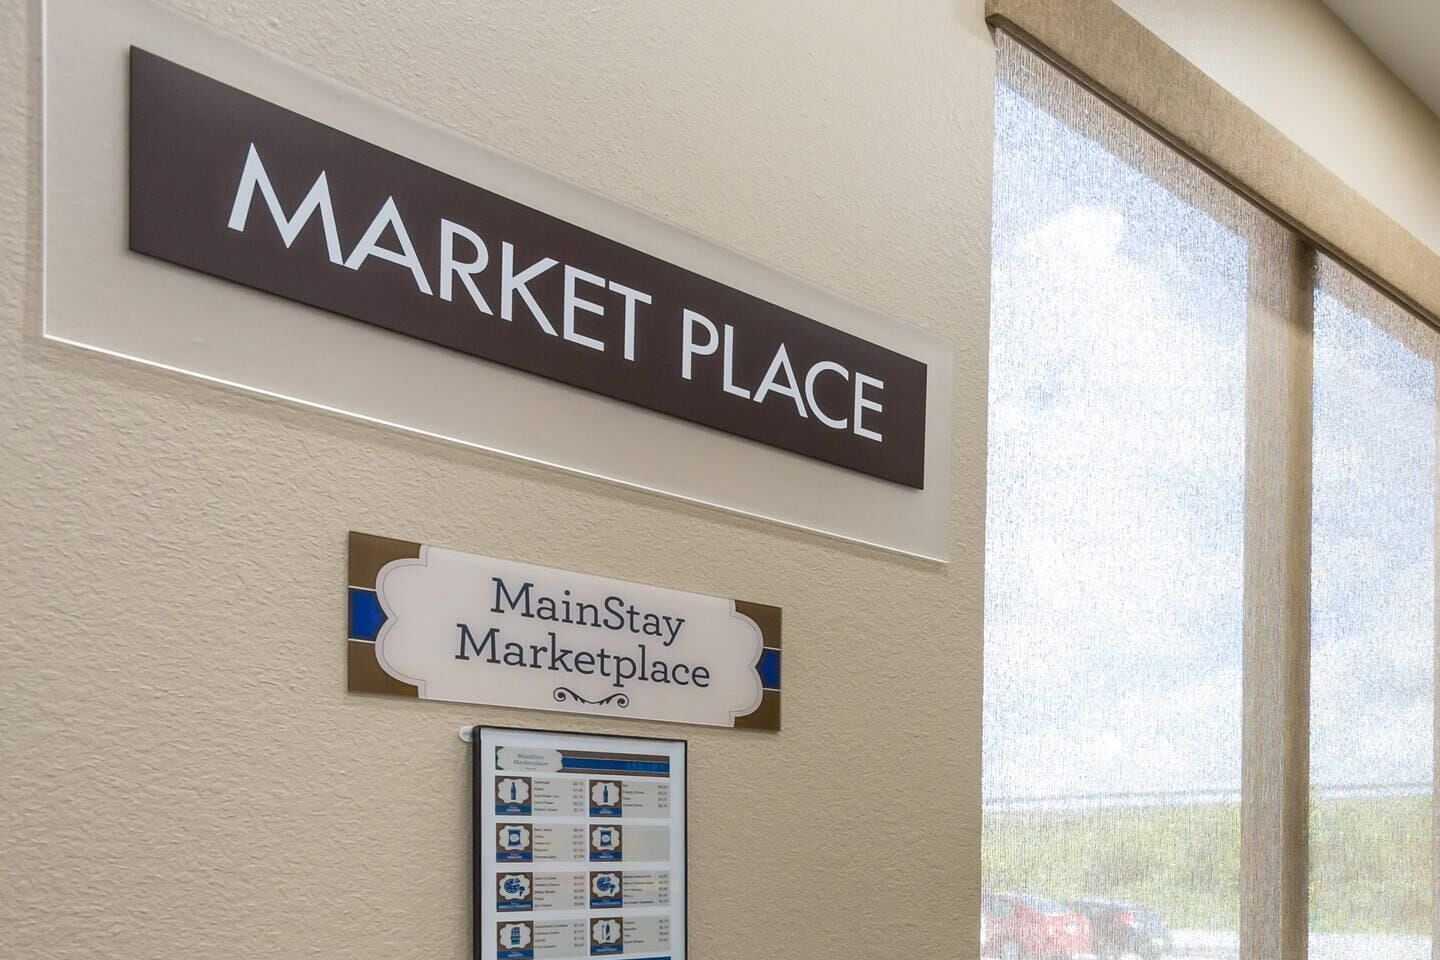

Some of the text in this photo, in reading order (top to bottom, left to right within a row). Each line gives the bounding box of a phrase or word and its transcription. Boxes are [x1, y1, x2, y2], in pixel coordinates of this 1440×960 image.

[227, 142, 885, 443] MARKET PLACE
[490, 577, 685, 647] MainStay
[454, 623, 710, 687] Marketplace
